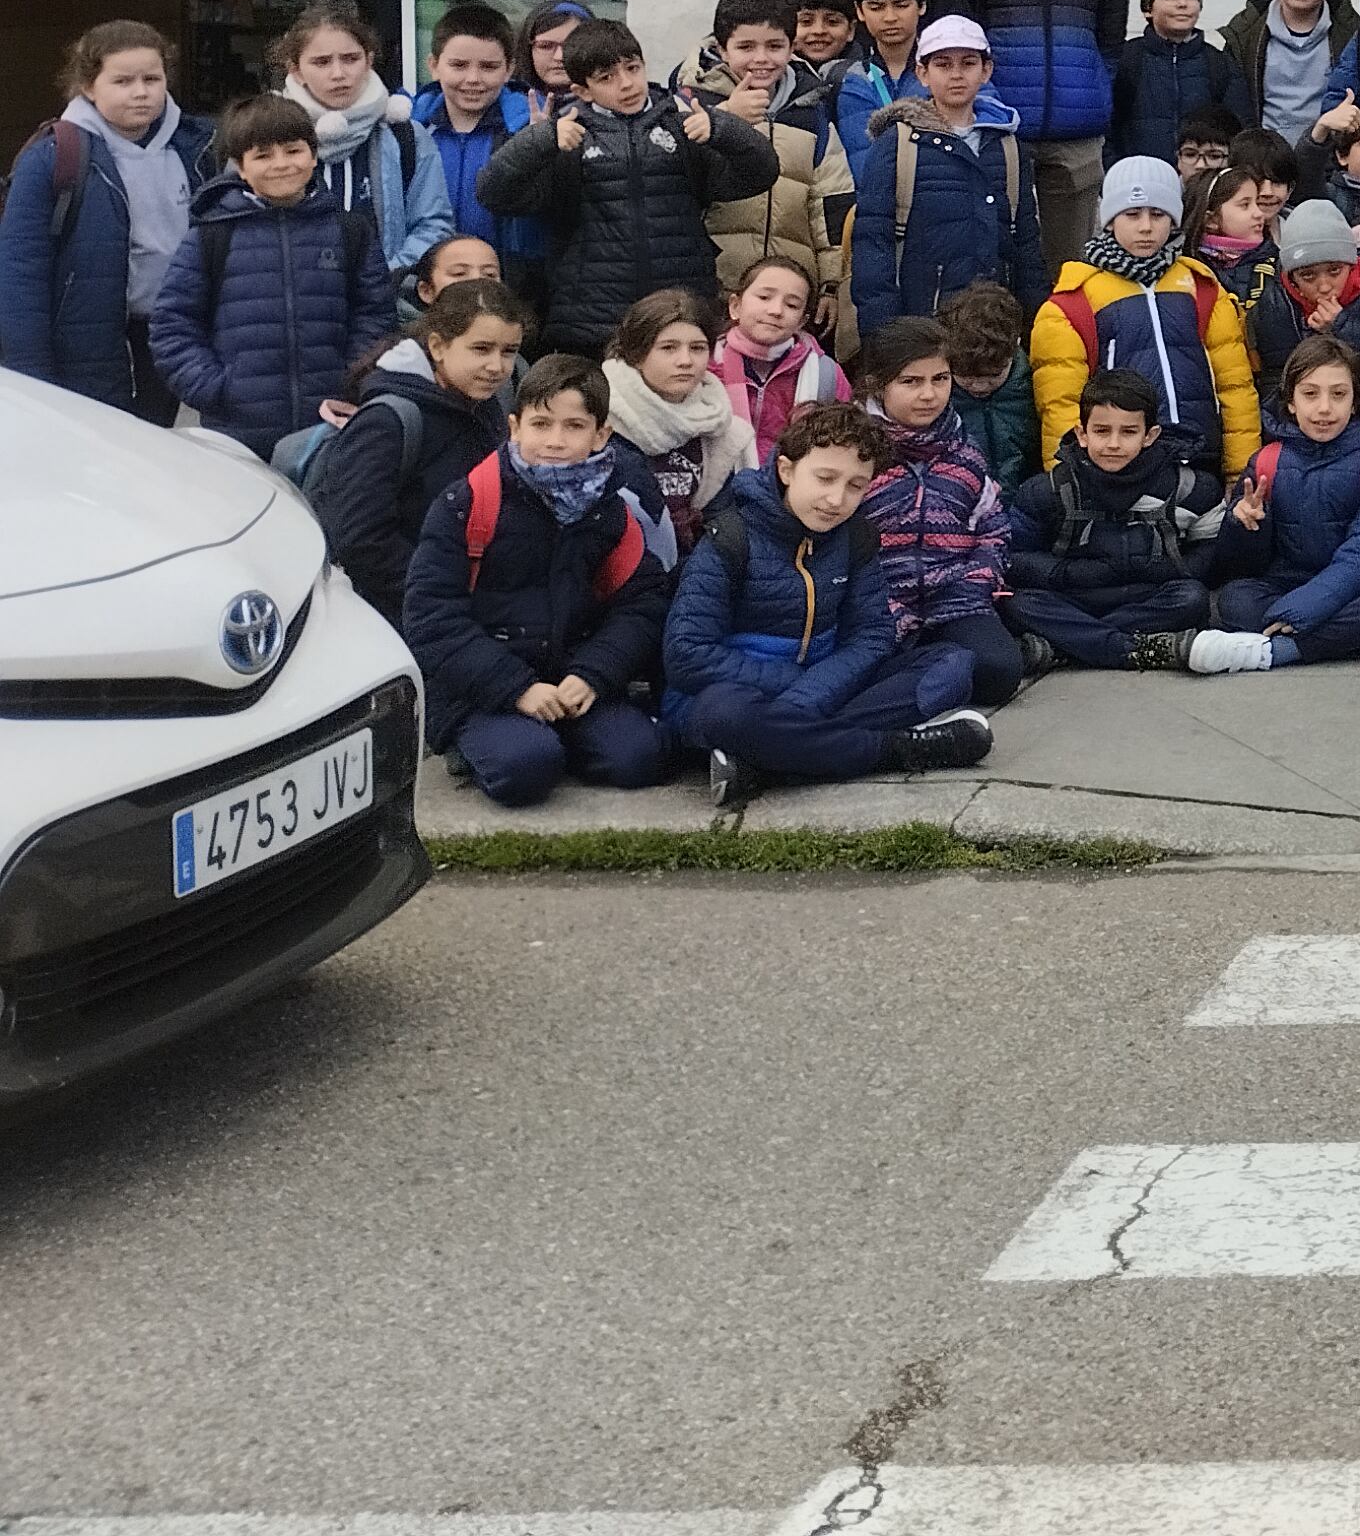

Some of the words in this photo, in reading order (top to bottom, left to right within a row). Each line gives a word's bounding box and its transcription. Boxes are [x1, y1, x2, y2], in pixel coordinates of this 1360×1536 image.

[206, 779, 299, 870] 4753
[313, 741, 368, 820] JVJ
[182, 861, 190, 880] E
